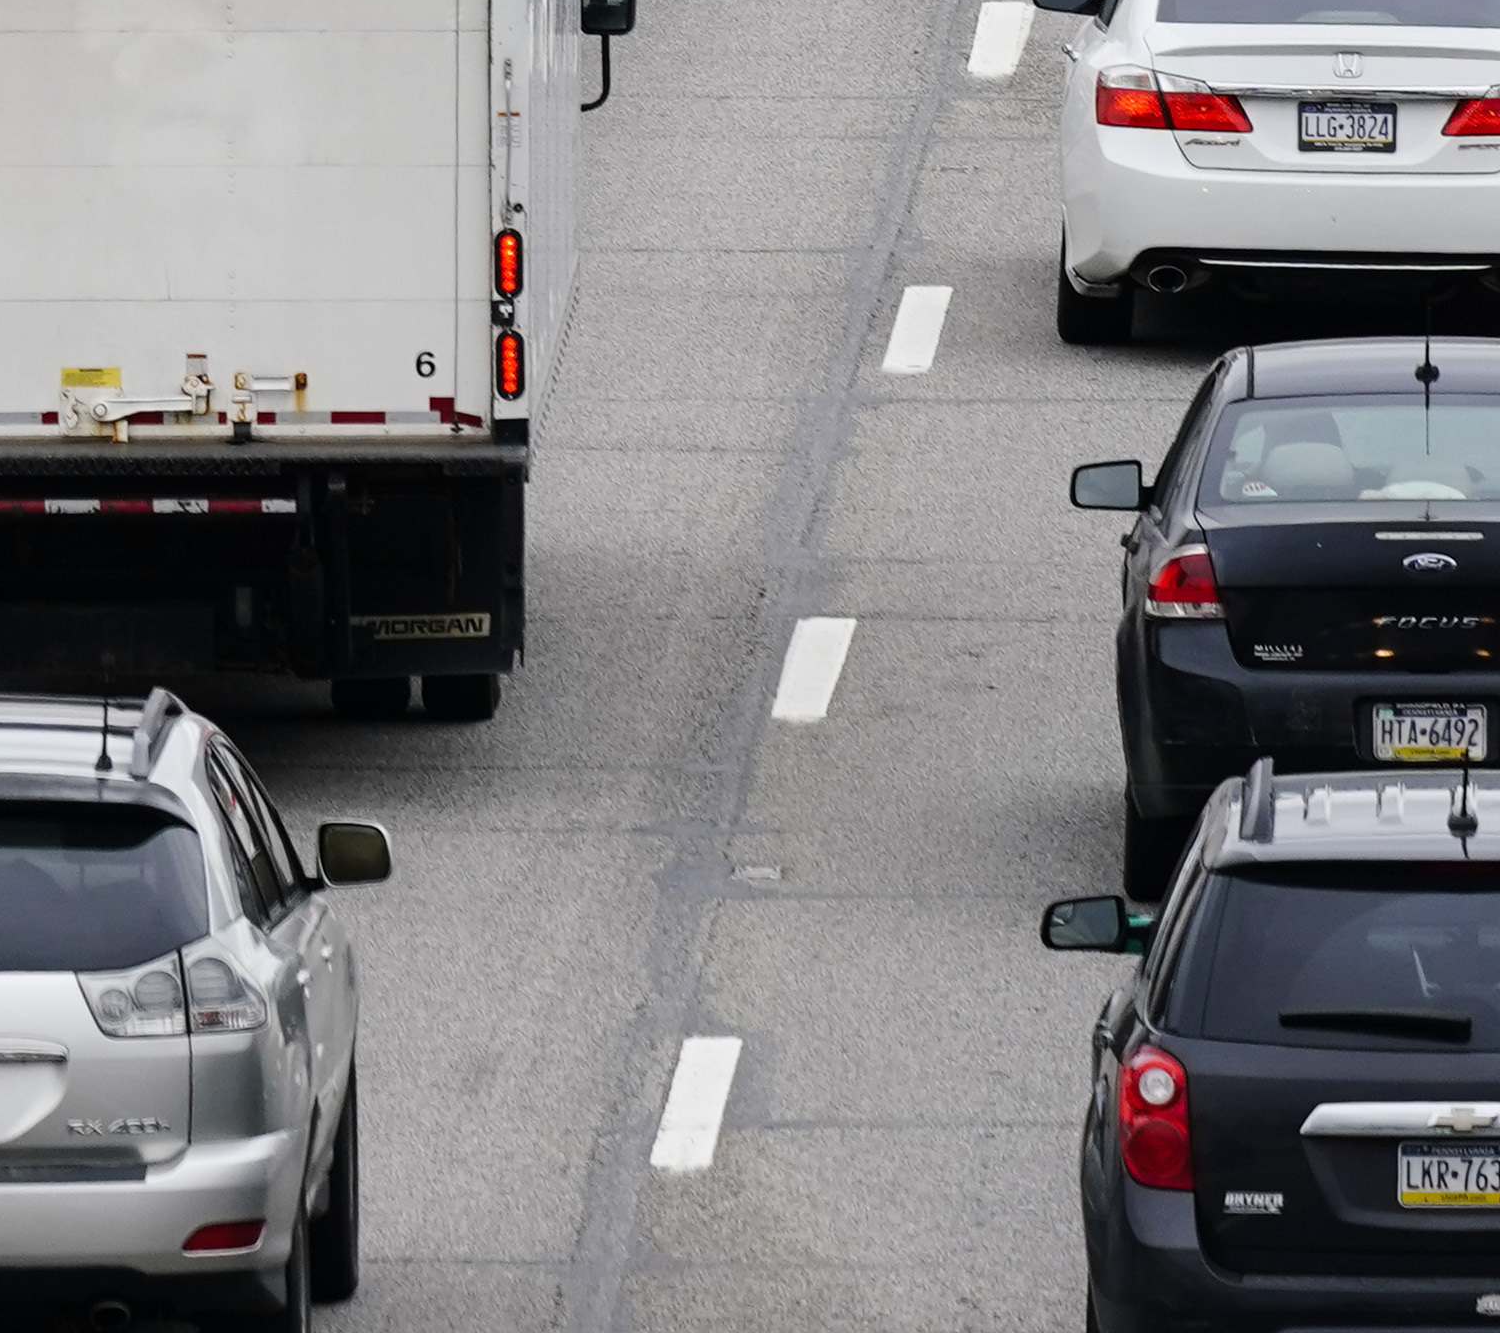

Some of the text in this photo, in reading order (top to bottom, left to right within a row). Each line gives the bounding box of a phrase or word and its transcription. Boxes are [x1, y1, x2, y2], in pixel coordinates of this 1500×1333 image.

[415, 351, 437, 378] 6
[1378, 615, 1480, 629] FOCUS
[66, 1117, 104, 1136] RX
